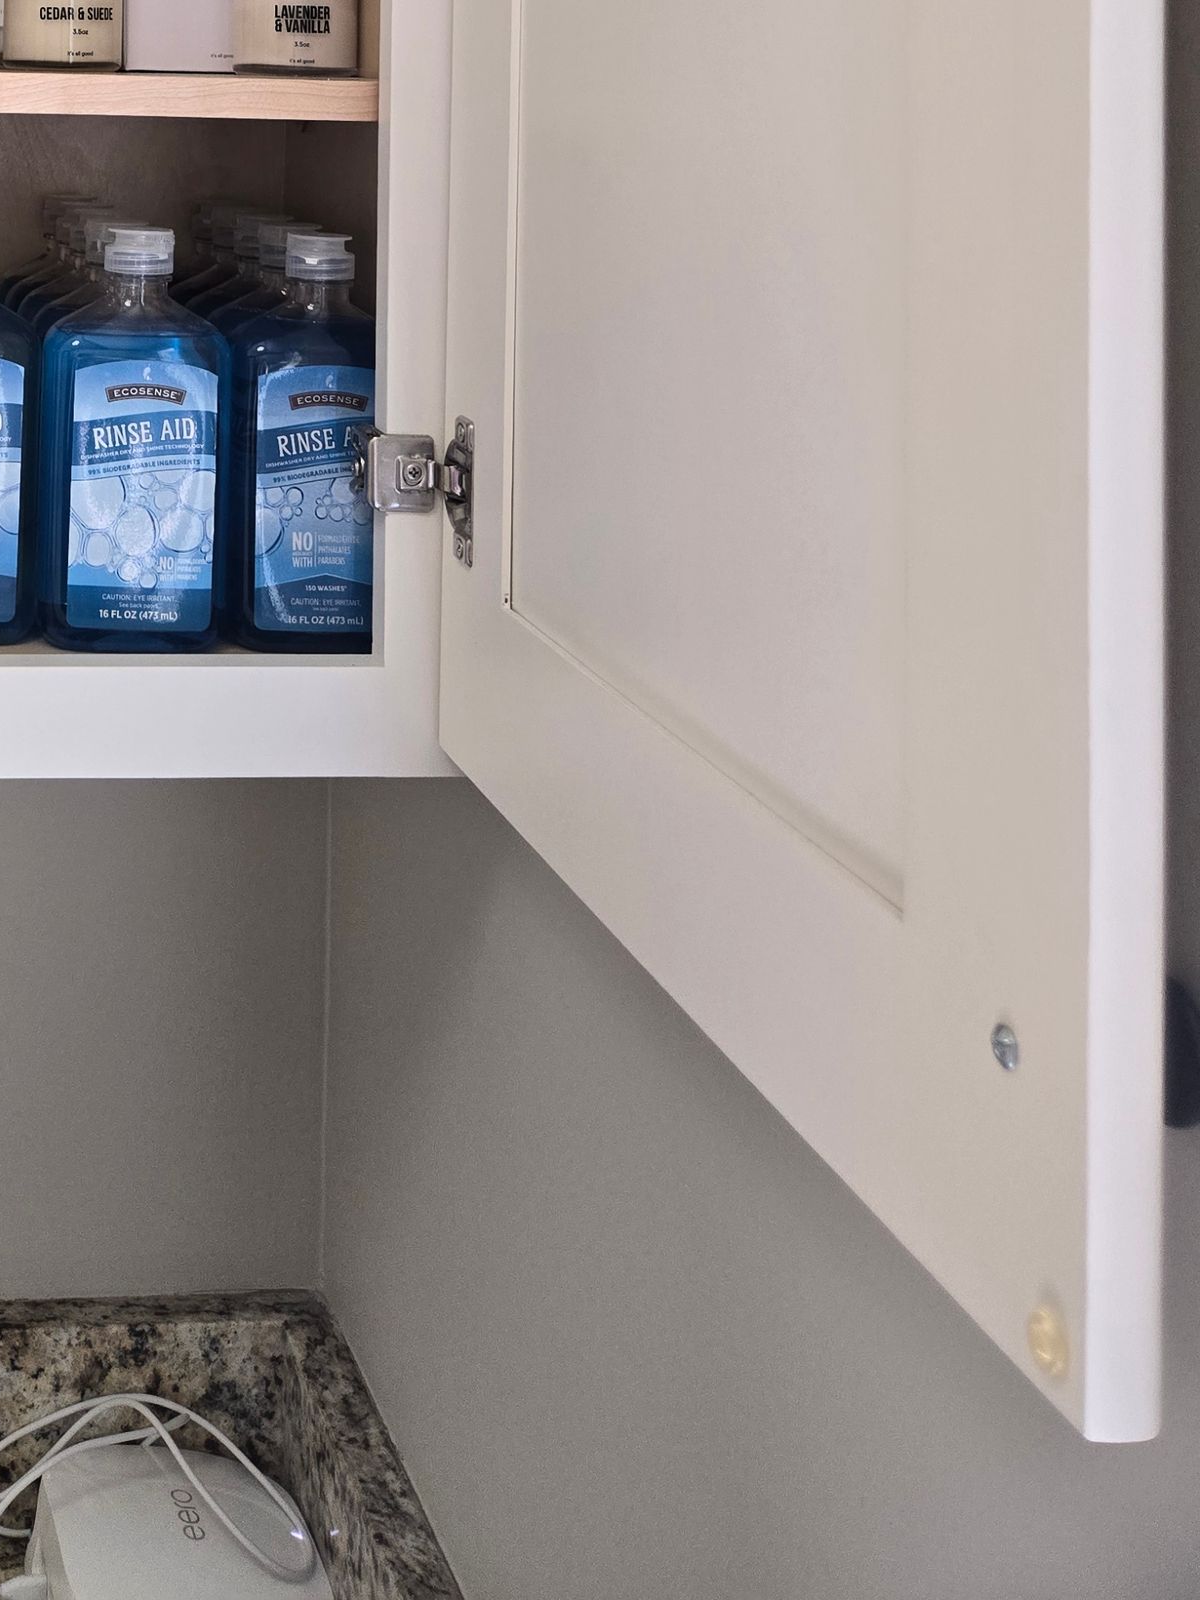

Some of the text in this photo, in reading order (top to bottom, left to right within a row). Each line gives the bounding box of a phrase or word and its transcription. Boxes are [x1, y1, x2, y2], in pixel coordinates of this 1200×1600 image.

[40, 7, 113, 21] CEDAR & SUEDE
[275, 5, 330, 20] LAVENDER
[275, 19, 330, 33] & VANILLA
[92, 418, 196, 449] RINSE AID
[277, 428, 335, 457] RINSE
[81, 450, 119, 460] DISHWASHER
[102, 461, 155, 474] BIODEGRADABLE
[266, 458, 302, 468] DISHWASHER
[287, 468, 339, 481] BIODEGRADABLE
[292, 531, 313, 551] NO
[160, 557, 174, 570] NO
[292, 557, 313, 568] WITH
[322, 598, 333, 606] EYE
[99, 609, 178, 621] 16 FL OZ (473 mL)
[289, 616, 364, 625] 16 FL OZ (473 mL)
[171, 1489, 205, 1540] eero
